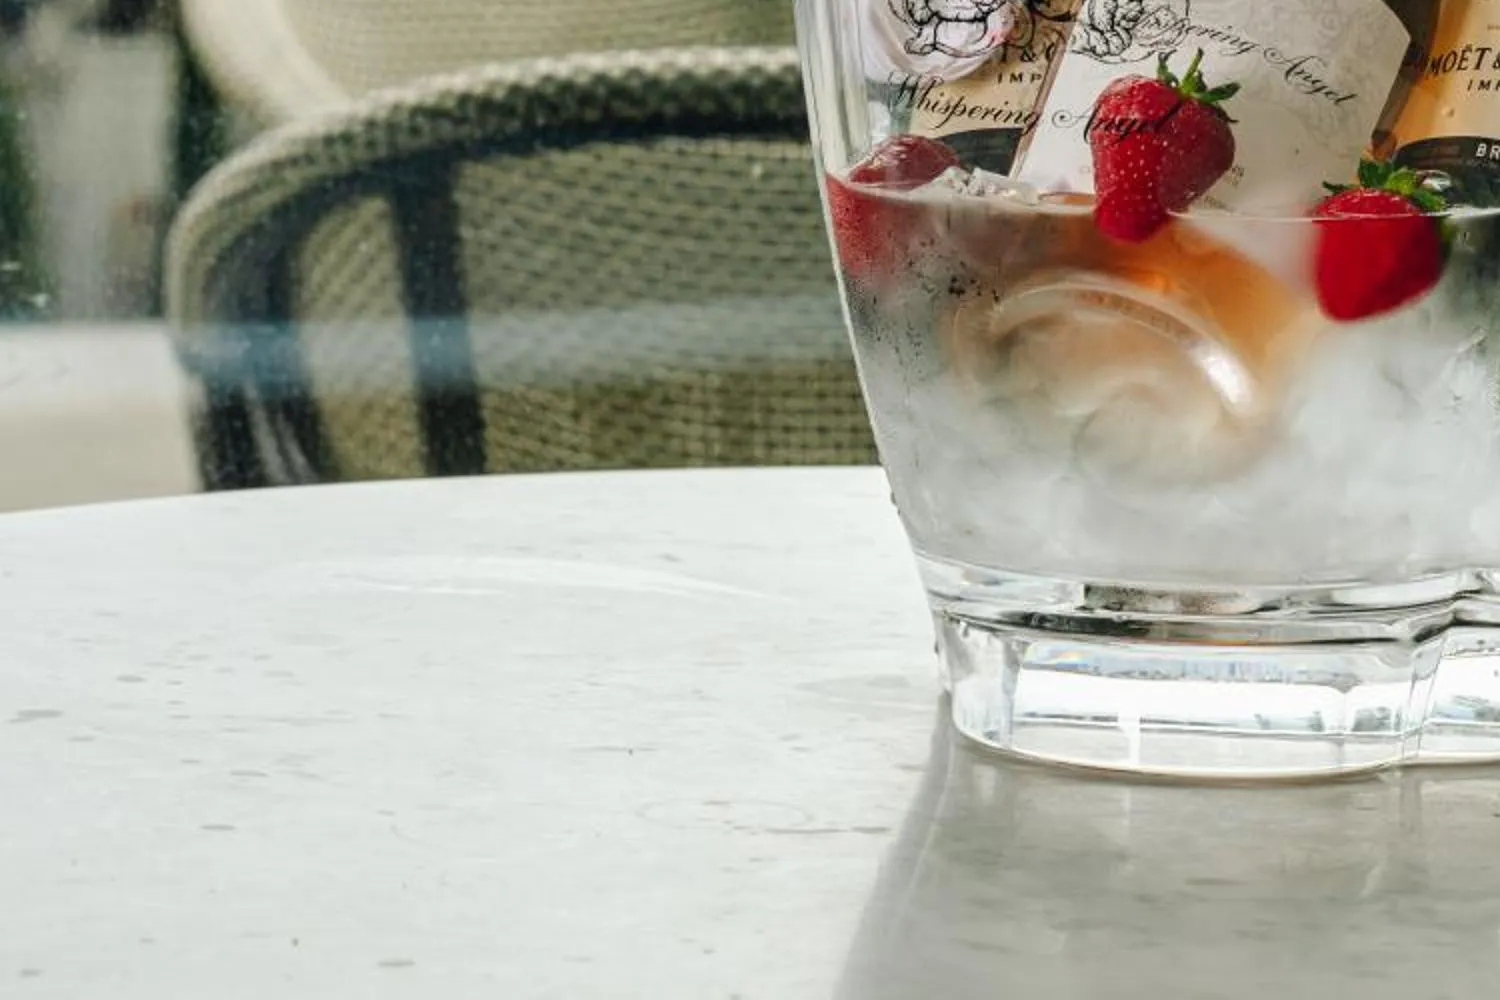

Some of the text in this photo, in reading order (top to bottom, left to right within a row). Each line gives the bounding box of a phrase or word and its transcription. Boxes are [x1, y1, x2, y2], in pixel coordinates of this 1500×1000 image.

[997, 71, 1043, 85] IMP
[1262, 46, 1358, 105] Angel
[887, 70, 1182, 144] Whispering Angel
